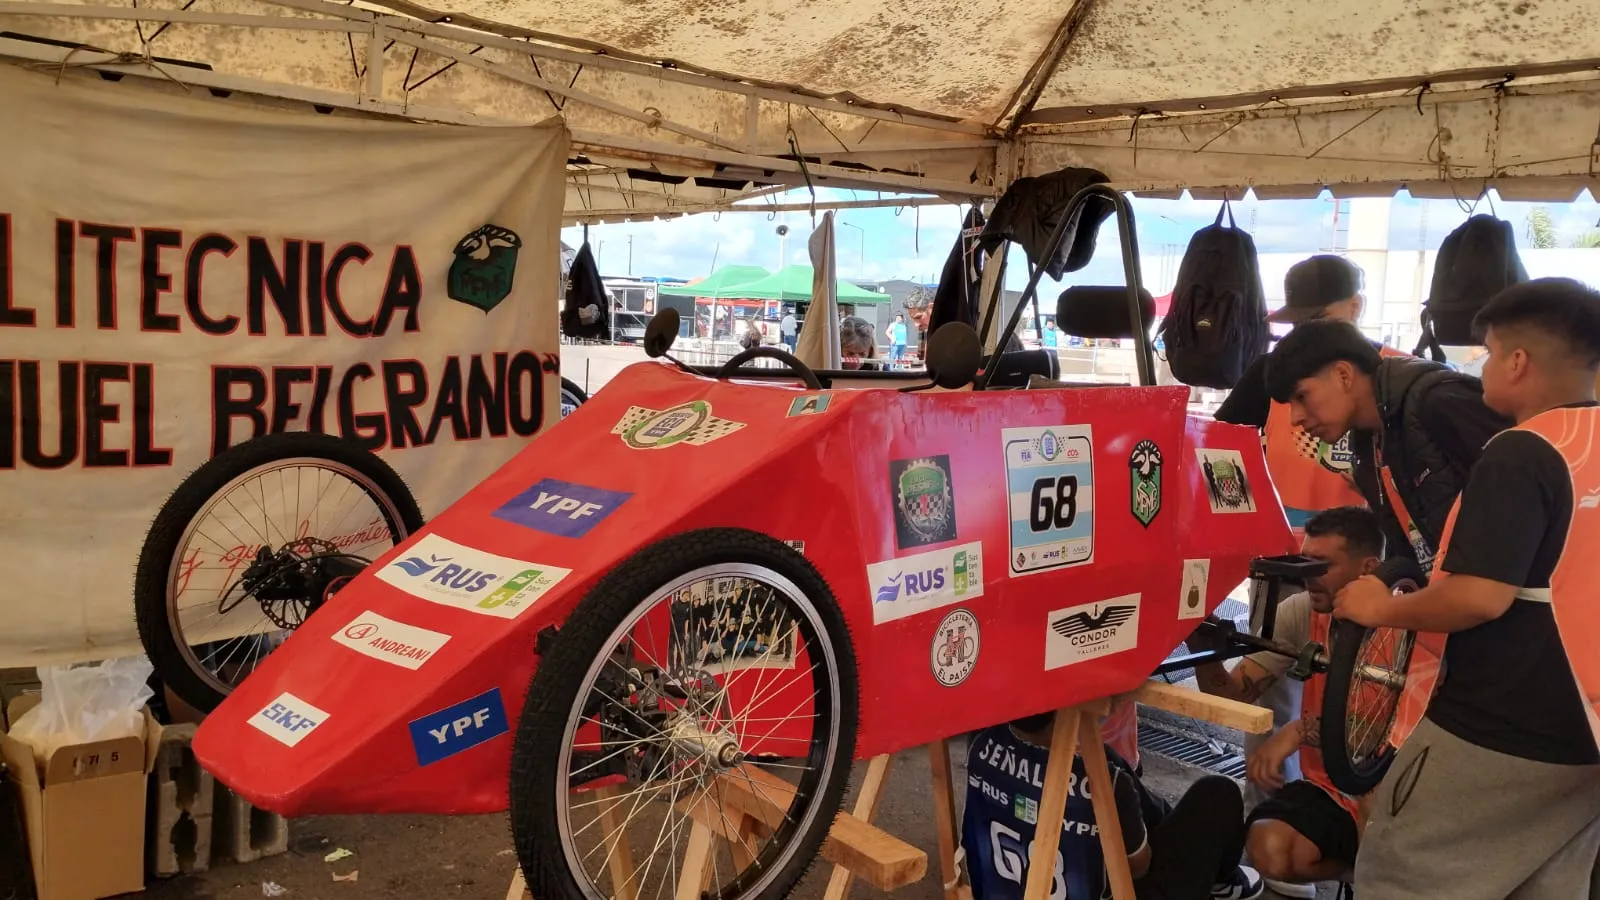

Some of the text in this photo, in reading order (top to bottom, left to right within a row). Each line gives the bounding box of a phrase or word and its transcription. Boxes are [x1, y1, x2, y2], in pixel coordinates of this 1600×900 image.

[800, 399, 817, 411] A
[529, 491, 604, 520] YPF
[1030, 475, 1078, 532] 68
[430, 563, 498, 593] RUS
[905, 567, 945, 596] RUS
[368, 637, 432, 661] ANDREANI
[1071, 628, 1117, 646] CONDOR
[1078, 643, 1110, 655] TALLERES
[938, 667, 946, 681] EL
[262, 702, 317, 732] SKF
[428, 707, 489, 744] YPF
[979, 737, 1092, 800] SEÑALRO
[982, 780, 1009, 806] RUS
